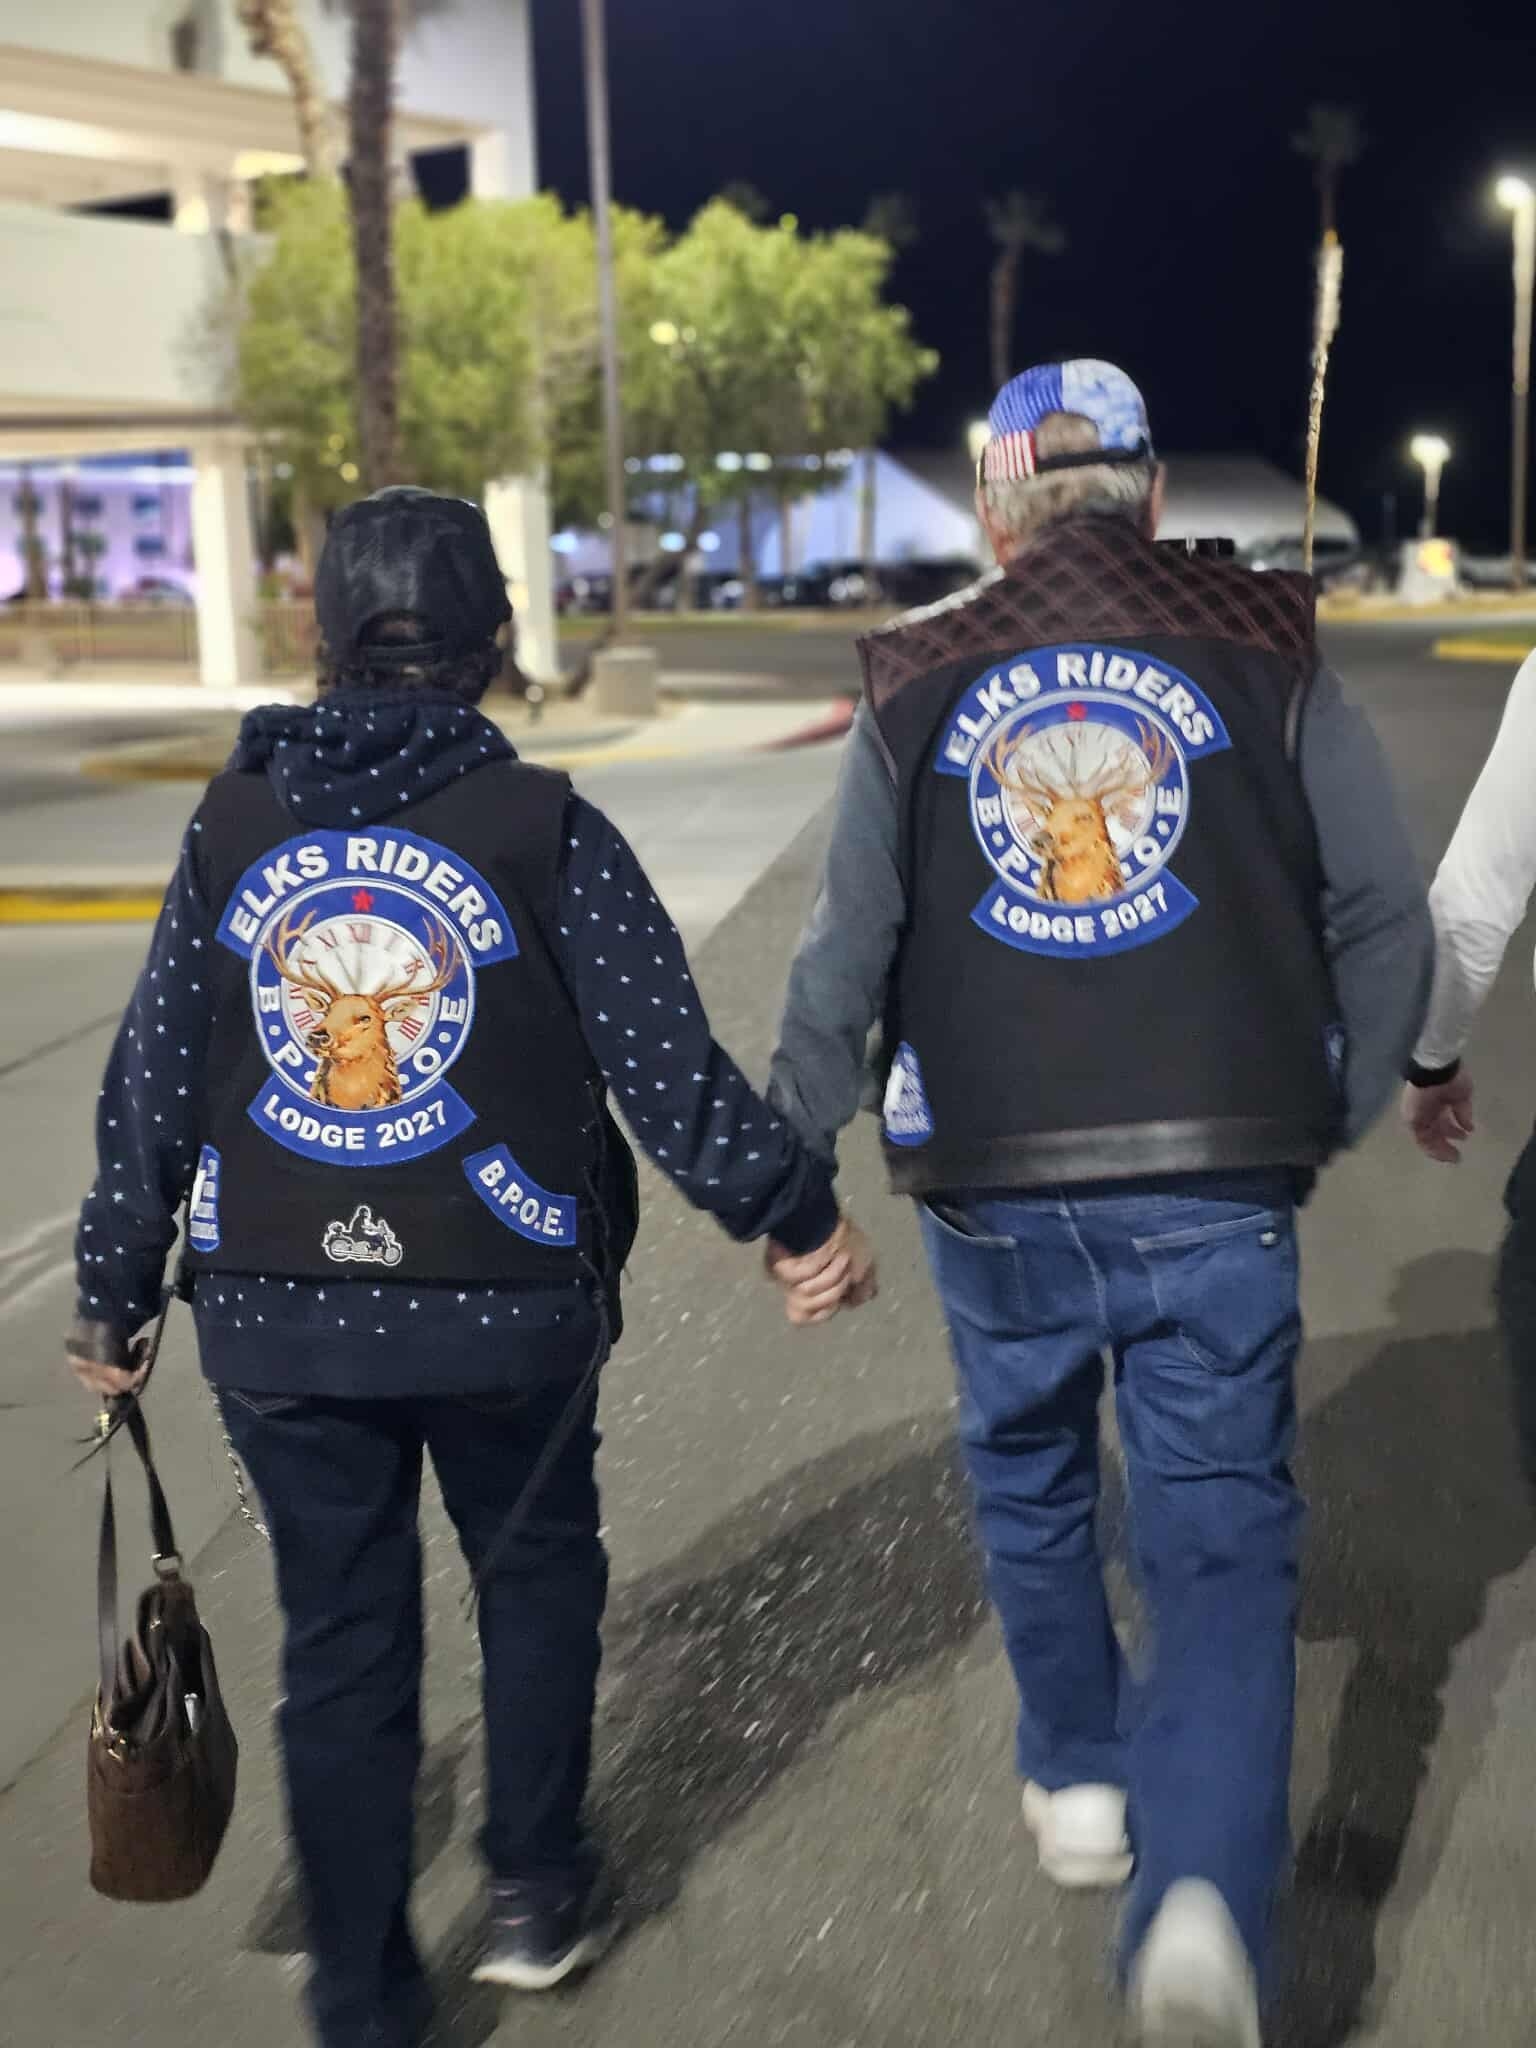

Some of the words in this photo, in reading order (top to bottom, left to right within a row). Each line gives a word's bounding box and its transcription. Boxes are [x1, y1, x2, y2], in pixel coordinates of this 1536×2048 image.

[944, 662, 1040, 766] ELKS
[1057, 651, 1215, 746] RIDERS
[228, 845, 330, 944] ELKS
[346, 837, 503, 952] RIDERS
[990, 895, 1096, 943] LODGE
[1100, 882, 1168, 938] 2027
[263, 1094, 365, 1150] LODGE
[375, 1099, 447, 1148] 2027
[478, 1159, 565, 1237] B.P.O.E.
